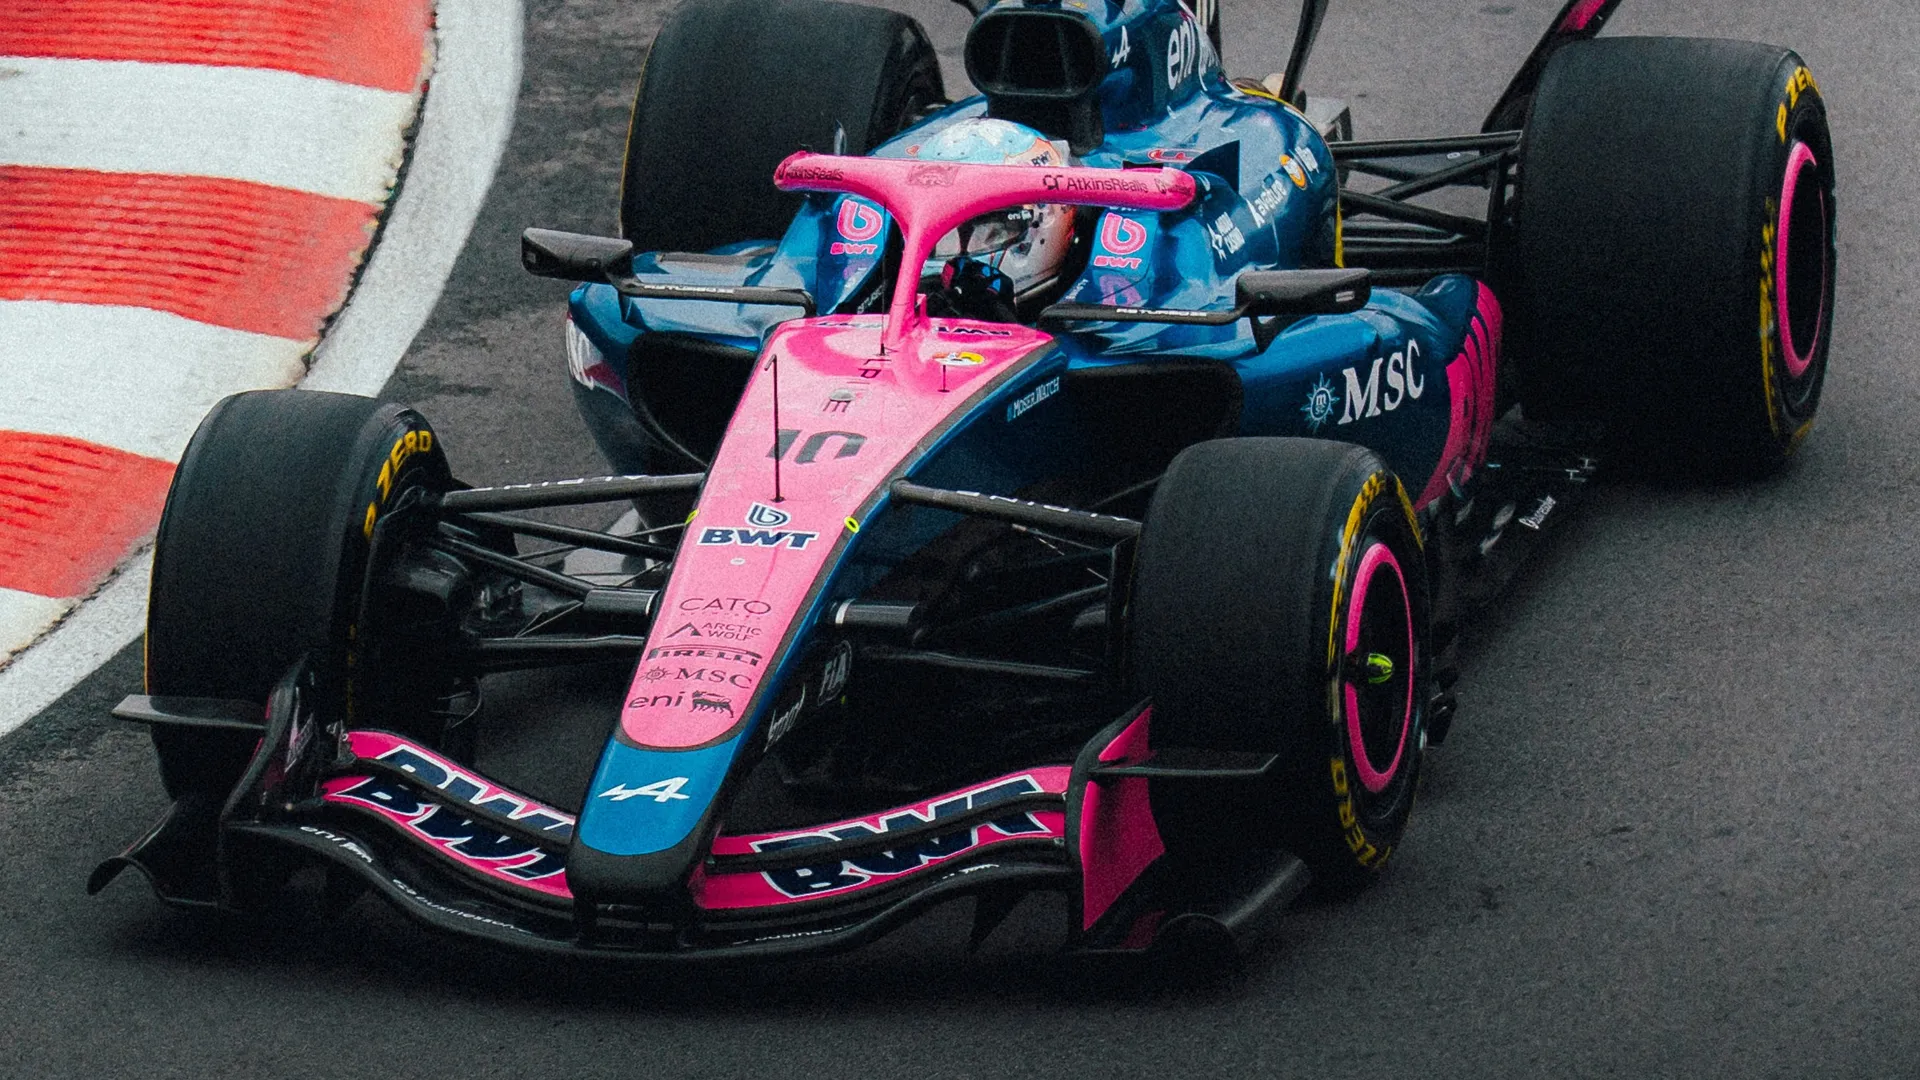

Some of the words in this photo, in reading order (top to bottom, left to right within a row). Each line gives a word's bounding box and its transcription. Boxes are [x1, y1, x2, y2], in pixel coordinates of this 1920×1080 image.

[1338, 338, 1424, 425] MSC
[698, 527, 819, 549] BWT
[679, 597, 772, 615] CATO
[701, 622, 763, 636] ARCTIC
[708, 630, 754, 641] WOLF
[646, 644, 763, 666] PIRELLI
[675, 667, 753, 689] MSC
[628, 691, 686, 709] eni
